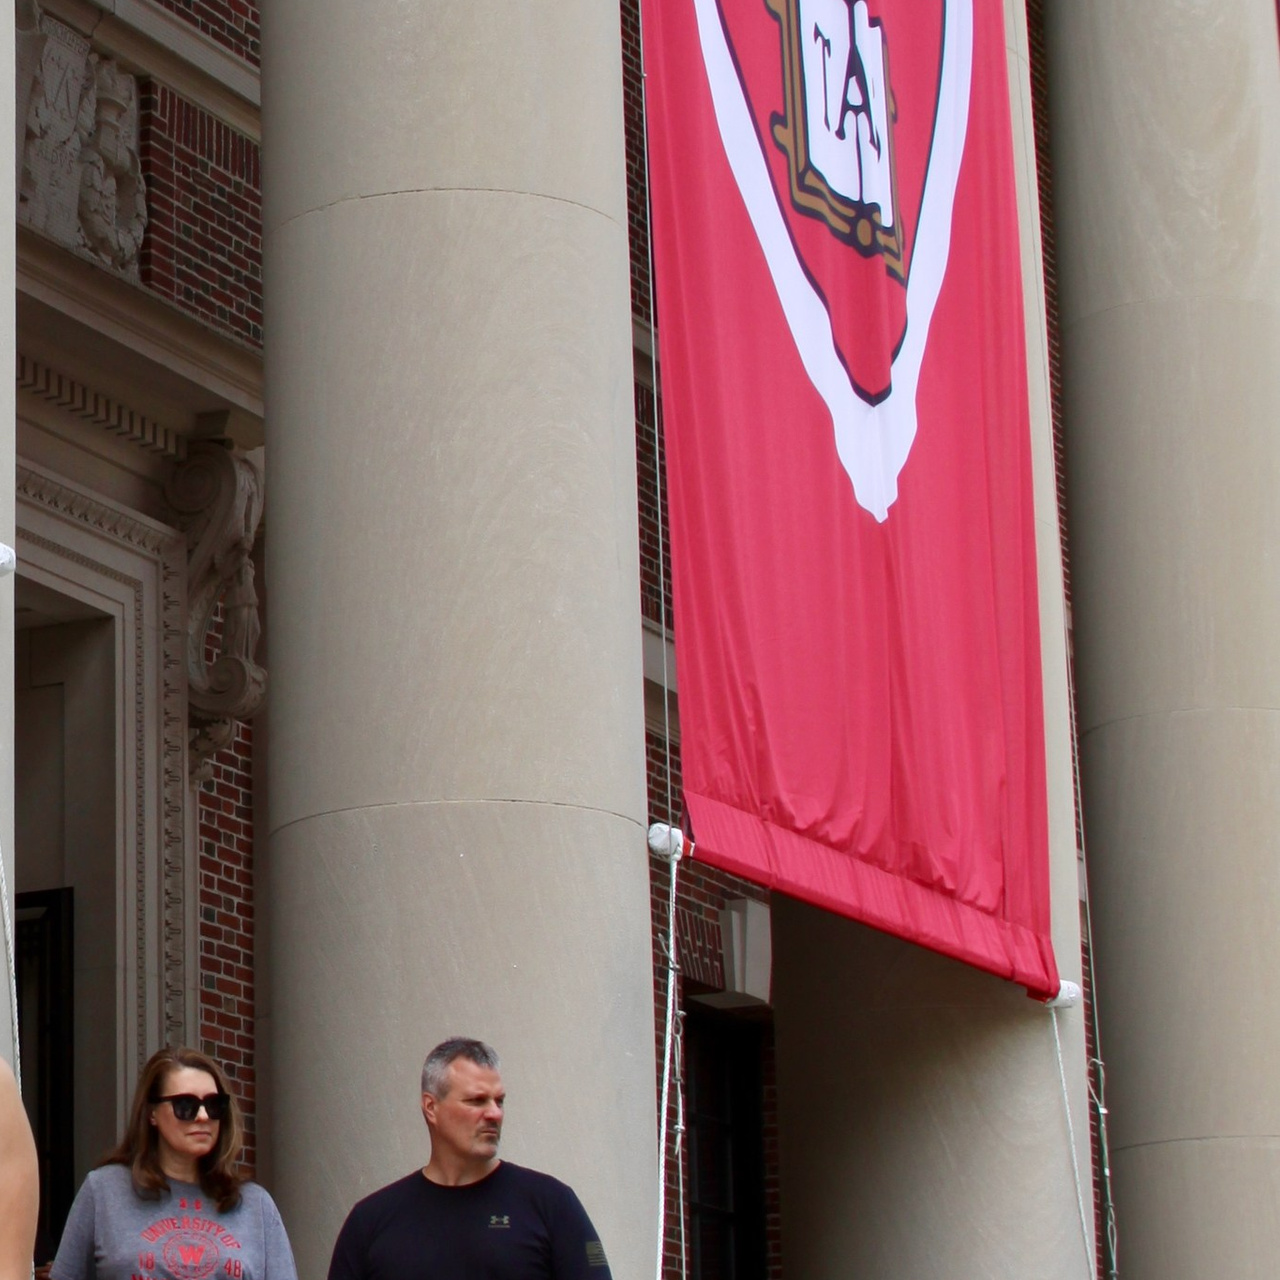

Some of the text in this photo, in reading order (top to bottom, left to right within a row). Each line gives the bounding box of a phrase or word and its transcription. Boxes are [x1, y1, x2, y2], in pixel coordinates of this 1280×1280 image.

[813, 21, 882, 163] TA
[140, 1215, 241, 1249] UNIVERSITY OF
[177, 1244, 206, 1267] W
